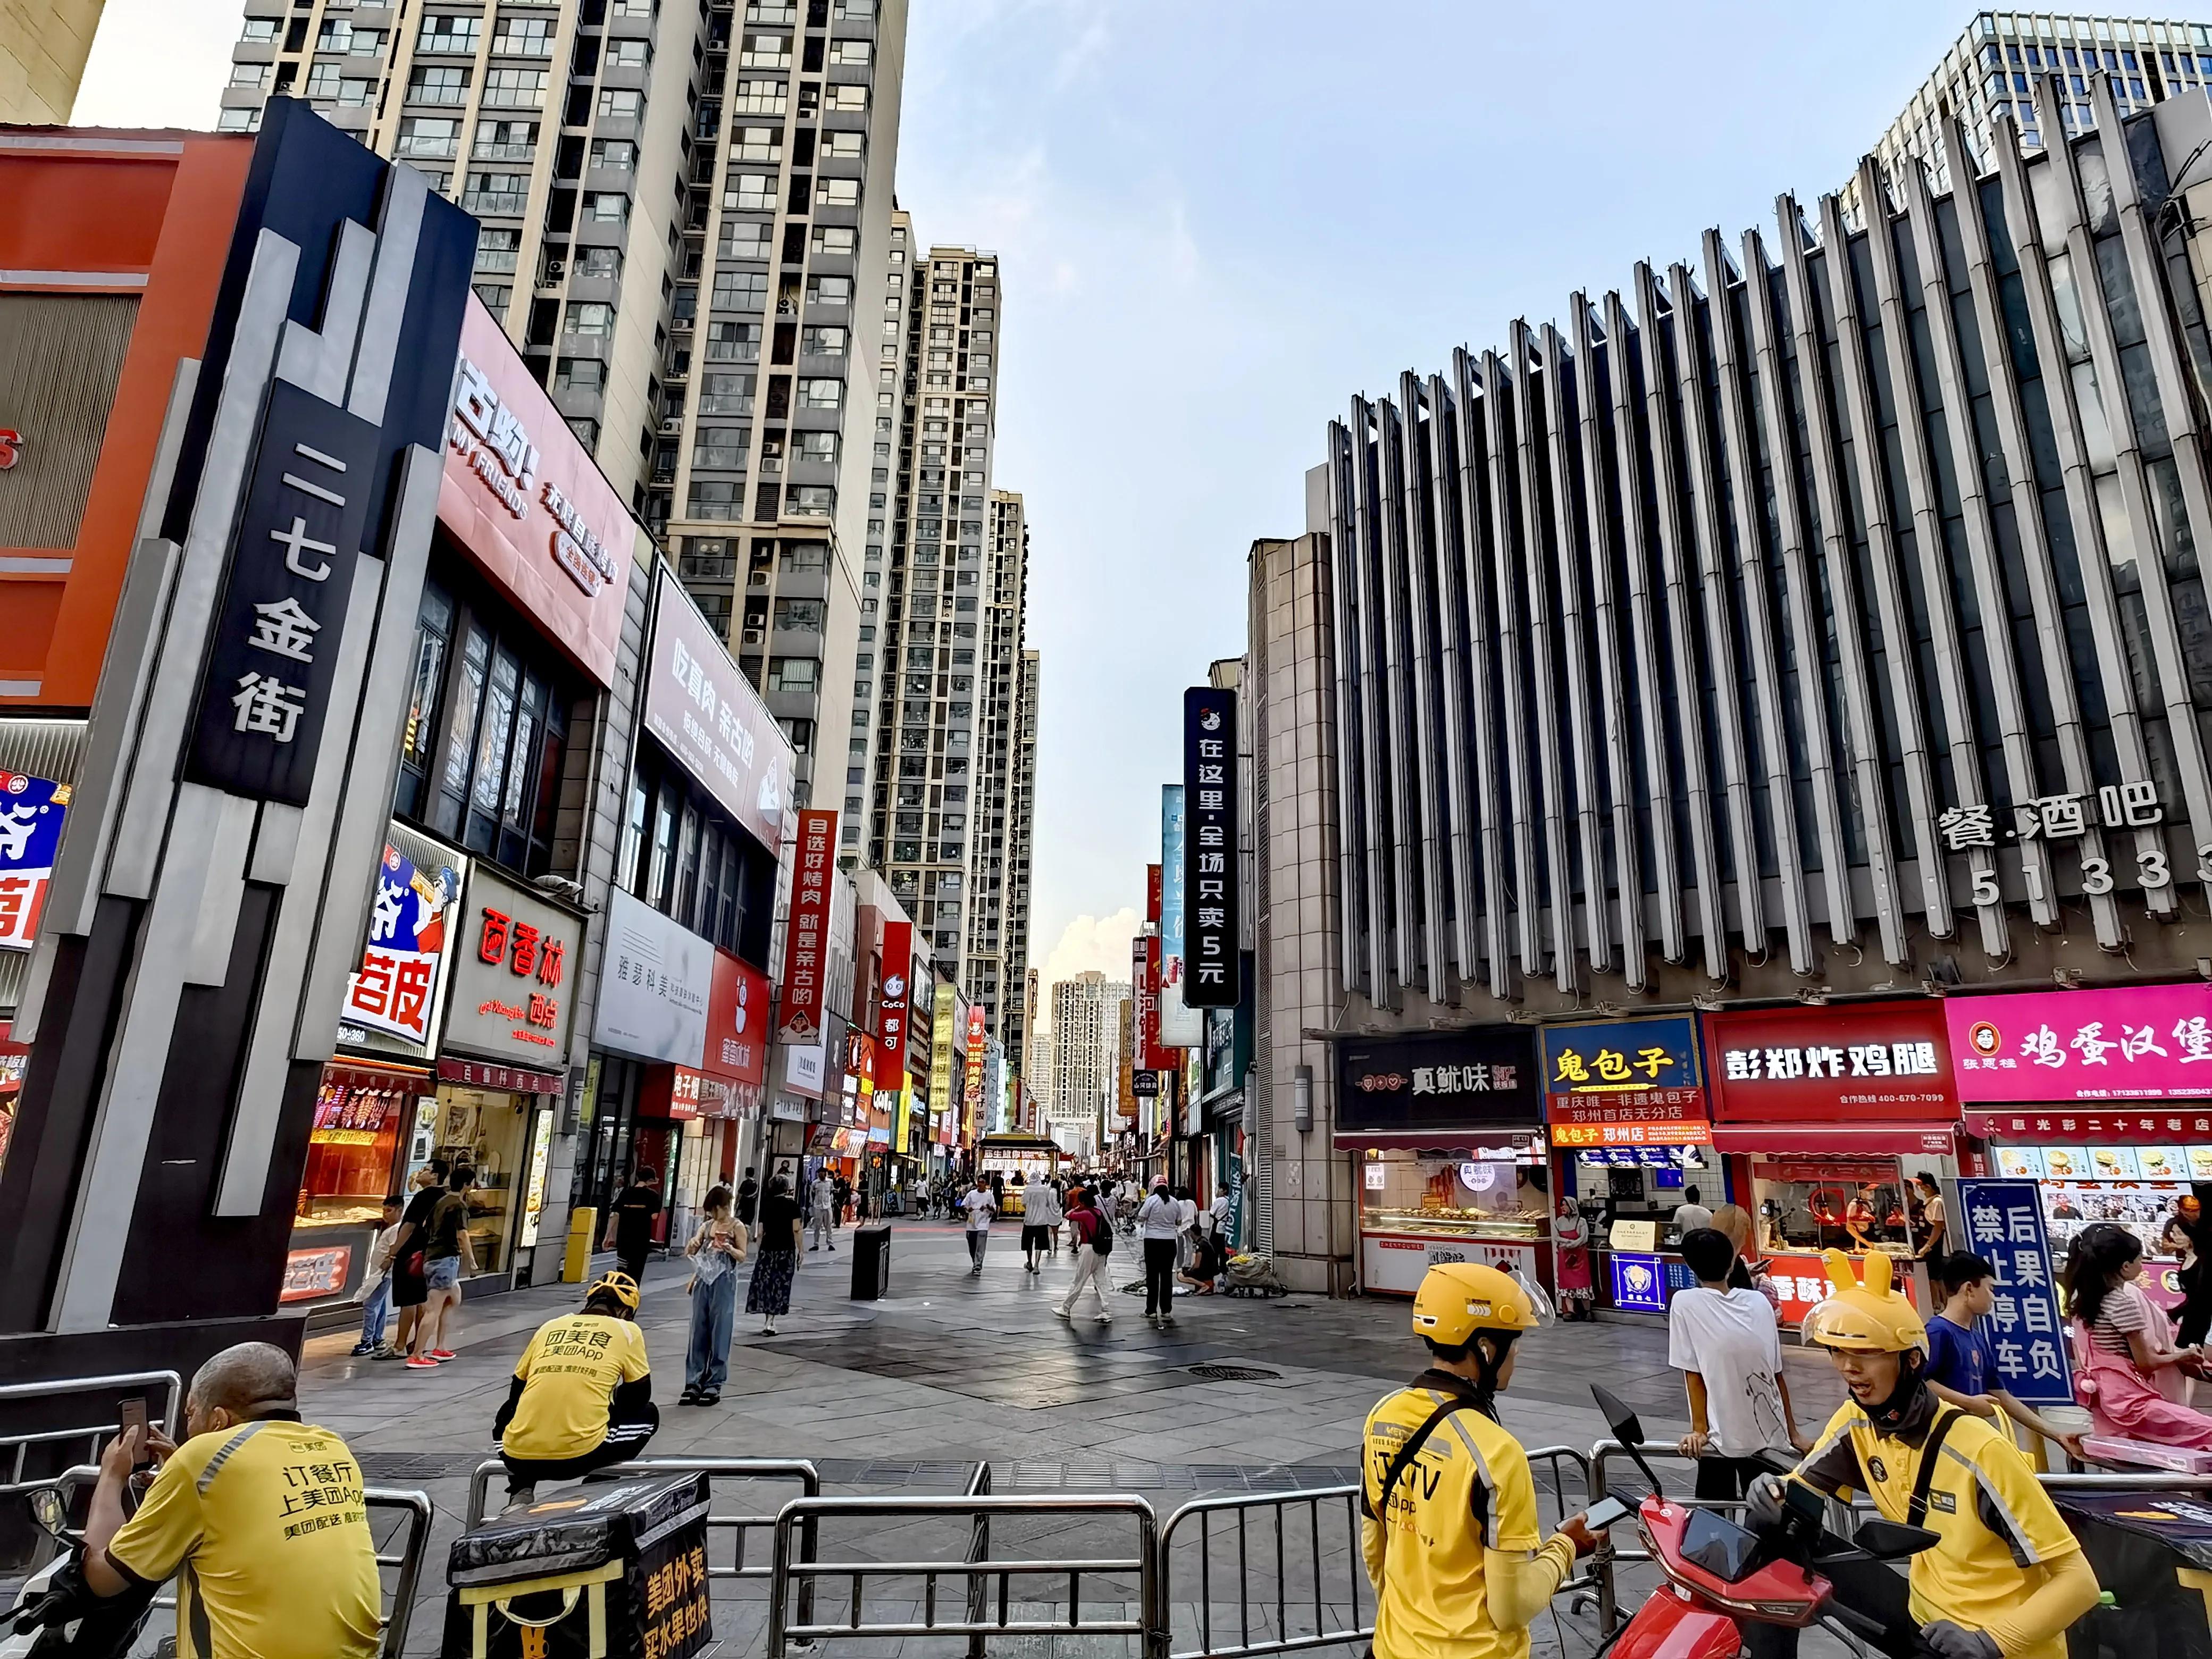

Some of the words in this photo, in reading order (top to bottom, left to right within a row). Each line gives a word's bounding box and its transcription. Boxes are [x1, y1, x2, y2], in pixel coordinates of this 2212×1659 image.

[453, 425, 476, 456] MY
[475, 454, 529, 521] FRIENDS
[230, 442, 346, 743] 二七金街
[672, 637, 716, 722] 吃真肉
[719, 700, 753, 770] 亲古哟
[801, 818, 827, 904] 自选好烤肉
[478, 907, 566, 988] 百香林
[792, 914, 819, 1005] 就是亲古哟
[351, 952, 433, 1034] 苕皮
[530, 992, 559, 1029] 西点
[882, 1000, 904, 1009] CoCo
[885, 1018, 899, 1051] 都可
[2018, 1016, 2212, 1068] 鸡蛋汉堡
[1411, 1062, 1490, 1096] 真鱿味
[1553, 1046, 1674, 1082] 鬼包子
[1724, 1042, 1938, 1081] 彭郑炸鸡腿
[674, 1071, 700, 1101] 电子烟
[1556, 1090, 1699, 1109] 重庆唯一非遗鬼包子
[1572, 1106, 1683, 1122] 郑州首店无分店
[1554, 1126, 1599, 1143] 鬼包子
[1603, 1126, 1644, 1143] 郑州店
[1972, 1205, 2027, 1380] 禁止停车
[2008, 1205, 2062, 1381] 后果自负
[539, 1345, 604, 1361] 上美团App
[545, 1329, 613, 1349] 团美食
[282, 1462, 352, 1487] 订餐厅
[283, 1513, 342, 1541] 美团配送
[647, 1545, 705, 1620] 美团外卖
[644, 1594, 708, 1659] 买水果也快
